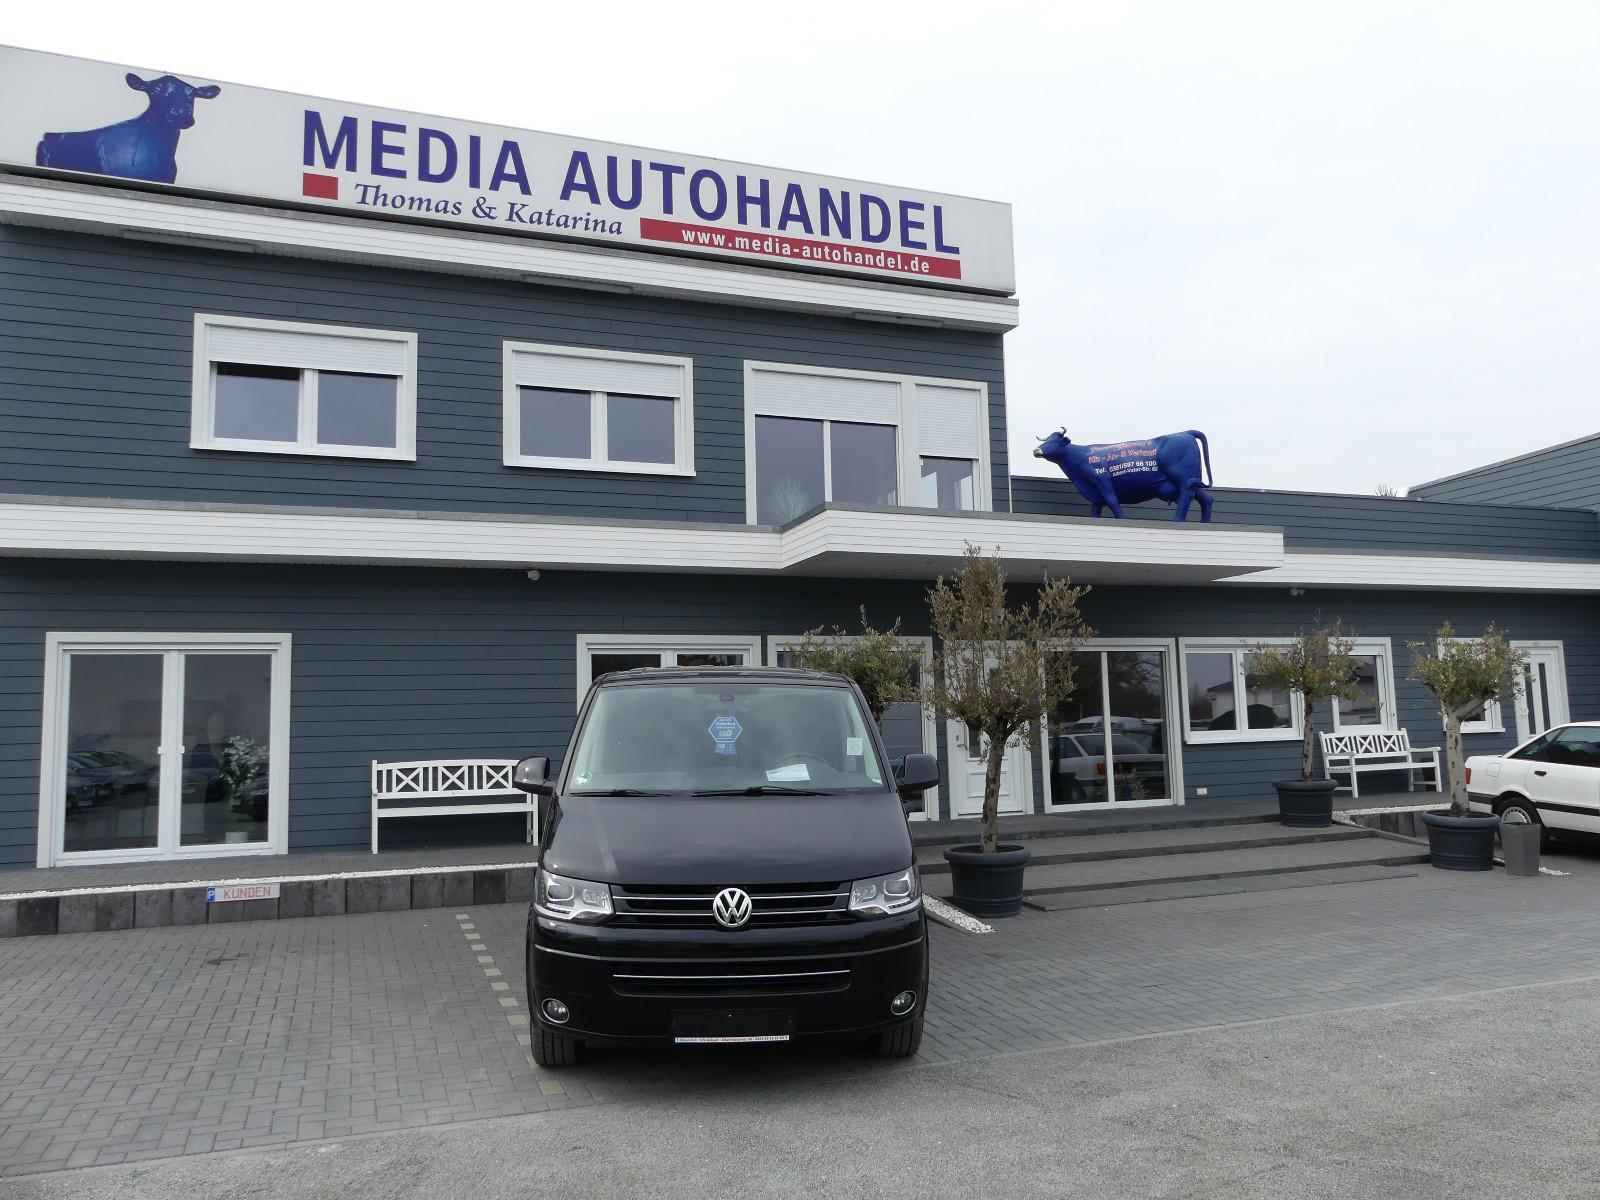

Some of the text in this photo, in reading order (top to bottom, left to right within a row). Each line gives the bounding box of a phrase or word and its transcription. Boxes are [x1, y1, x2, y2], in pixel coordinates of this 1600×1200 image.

[303, 109, 960, 255] MEDIA AUTOHANDEL
[354, 183, 624, 236] Thomas & Katarina
[681, 228, 931, 274] www.media-autohandel.de
[208, 886, 271, 900] P KUNDEN
